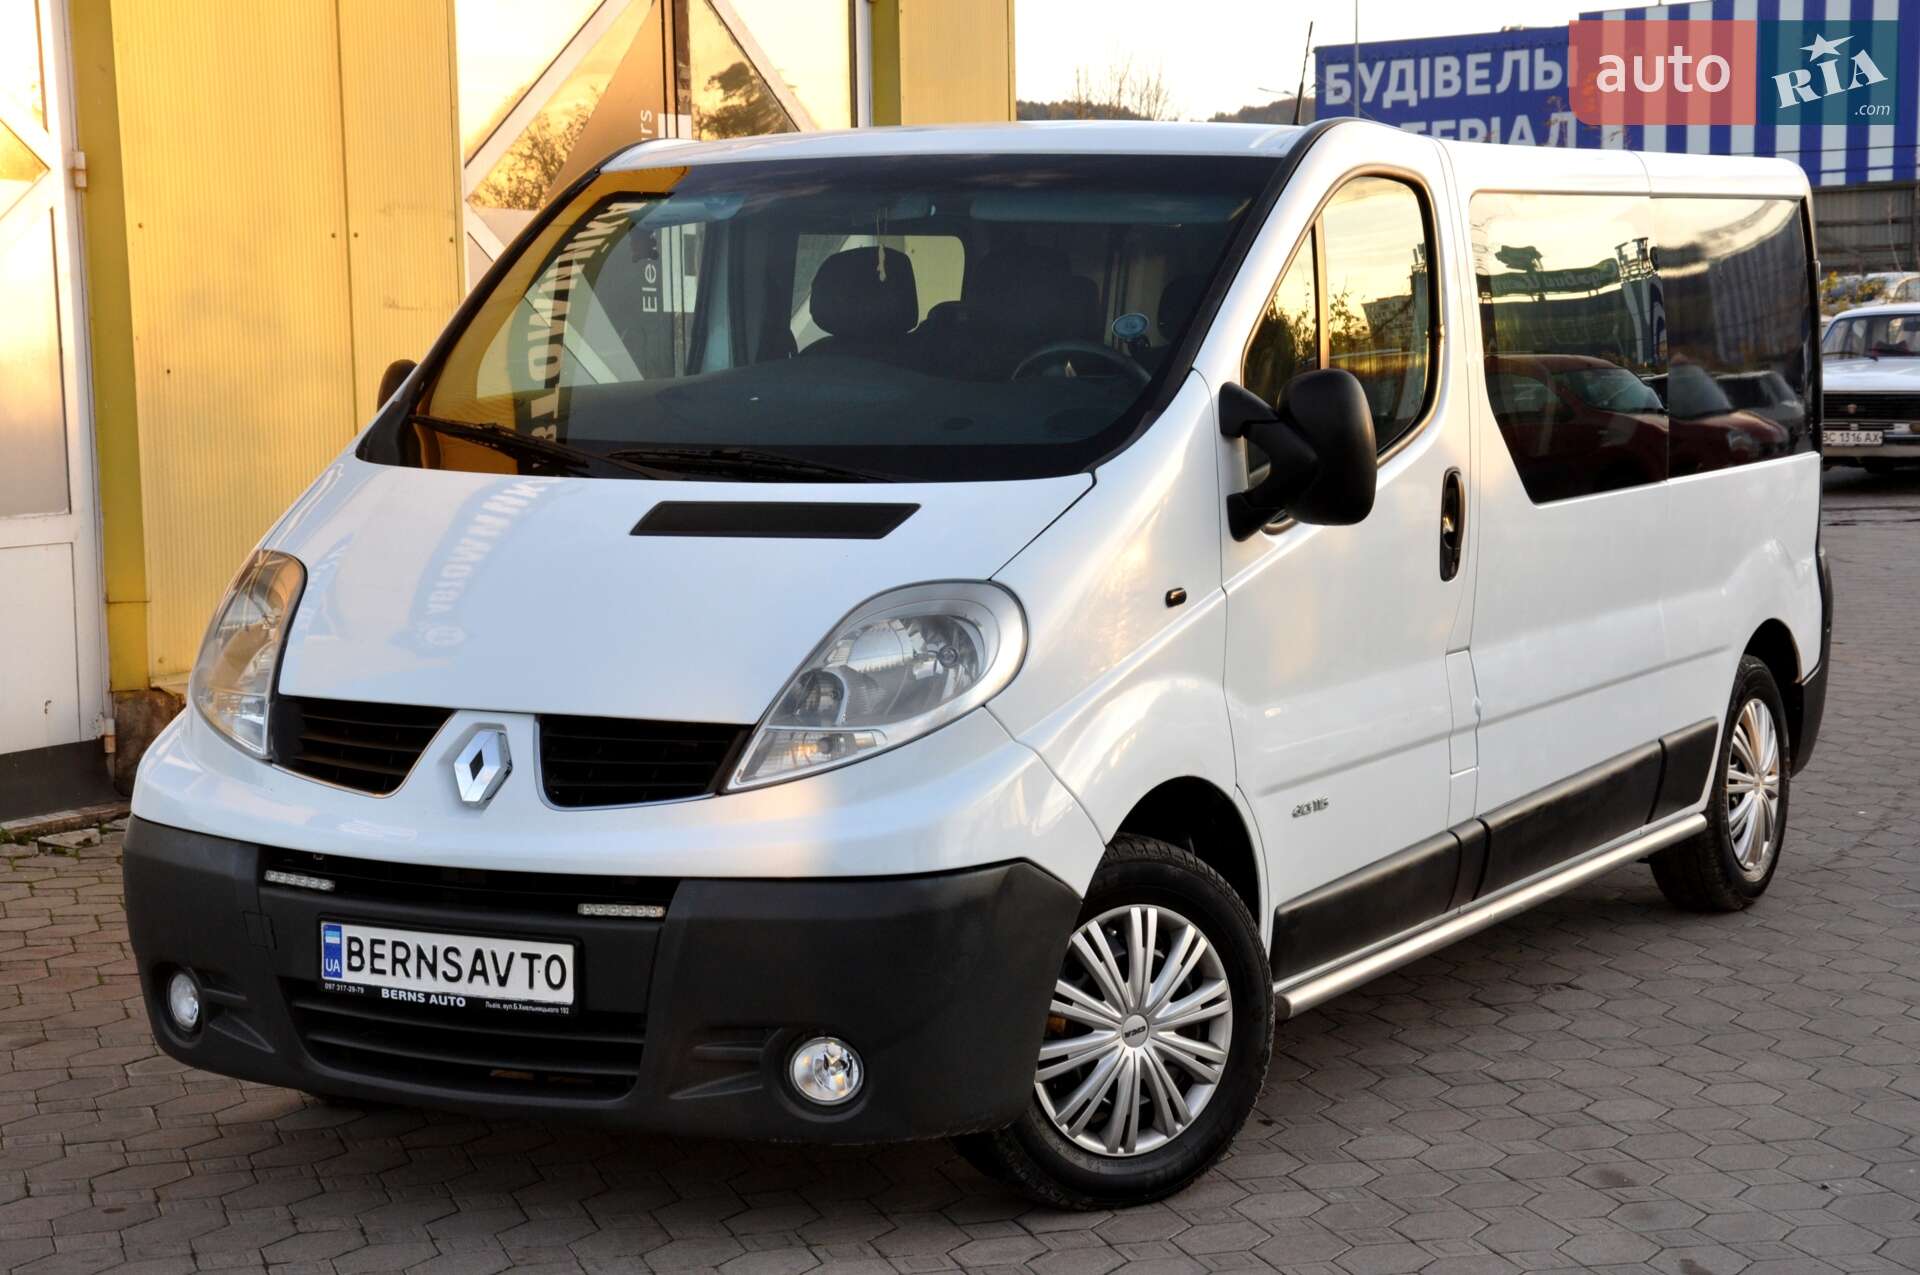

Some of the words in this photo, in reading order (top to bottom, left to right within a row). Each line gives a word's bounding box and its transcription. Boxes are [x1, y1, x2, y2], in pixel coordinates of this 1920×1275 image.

[1325, 45, 1578, 108] БУДІВЕЛЬ
[1400, 111, 1577, 148] РІАЛ
[325, 958, 341, 974] UA
[346, 935, 567, 990] BERNSAVTO
[381, 988, 425, 1003] BERNS
[429, 994, 466, 1007] AUTO
